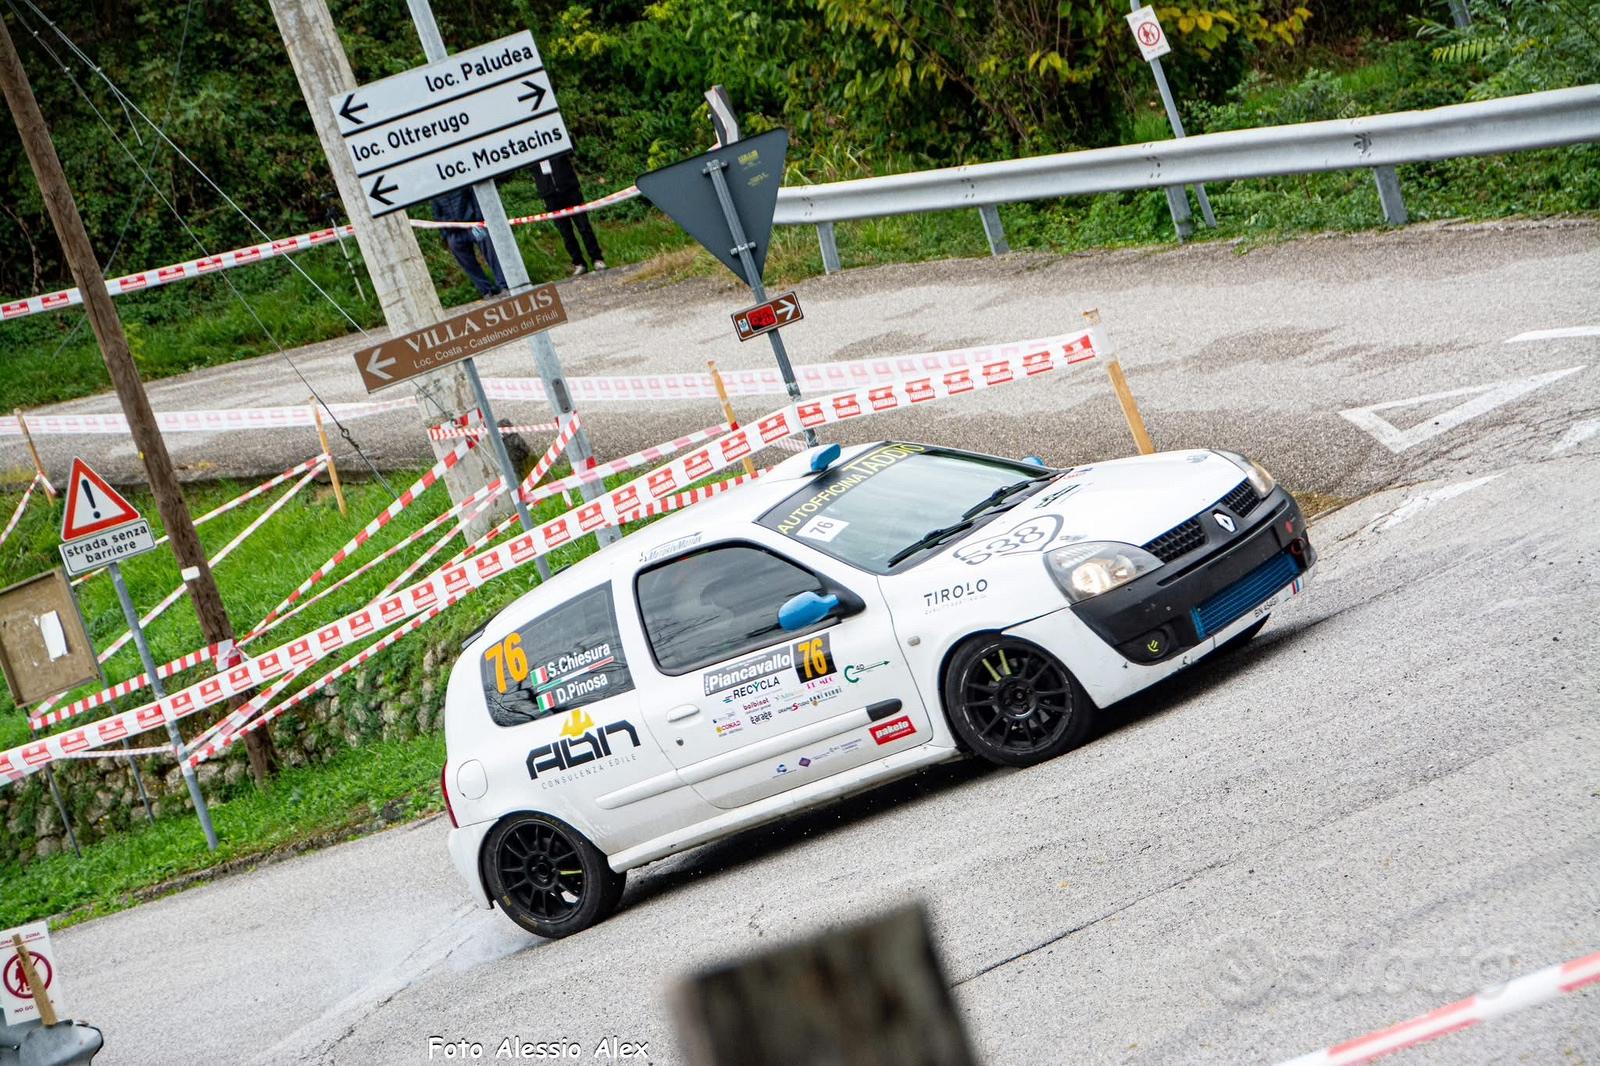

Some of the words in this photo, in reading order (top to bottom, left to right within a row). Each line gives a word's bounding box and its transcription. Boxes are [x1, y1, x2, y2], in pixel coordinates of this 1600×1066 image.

[425, 75, 459, 92] loc.
[461, 46, 533, 80] Paludea
[352, 144, 385, 161] loc.
[387, 112, 470, 149] Oltrerugo
[436, 163, 471, 180] loc.
[472, 126, 562, 168] Mostacins
[404, 318, 481, 353] VILLA
[484, 288, 553, 327] SULIS
[413, 356, 434, 369] Loc.
[435, 345, 463, 360] Costa
[470, 326, 519, 348] Castelnovo
[521, 318, 534, 330] del
[536, 311, 558, 325] Friuli
[777, 473, 867, 534] AUTOFFICINA
[842, 443, 925, 475] TADDIO
[67, 537, 108, 557] strada
[111, 525, 147, 543] senza
[809, 521, 834, 534] 76
[86, 540, 136, 563] barriere
[923, 578, 988, 607] TIROLO
[485, 632, 528, 695] 76
[547, 643, 611, 678] S.Chiesura
[709, 652, 792, 691] Piancavallo
[798, 638, 828, 679] 76
[556, 672, 609, 704] D.Pinosa
[733, 676, 780, 699] RECYCLA
[875, 720, 909, 739] pakelo
[542, 764, 605, 790] CONSULENZA
[609, 753, 637, 768] EDILE
